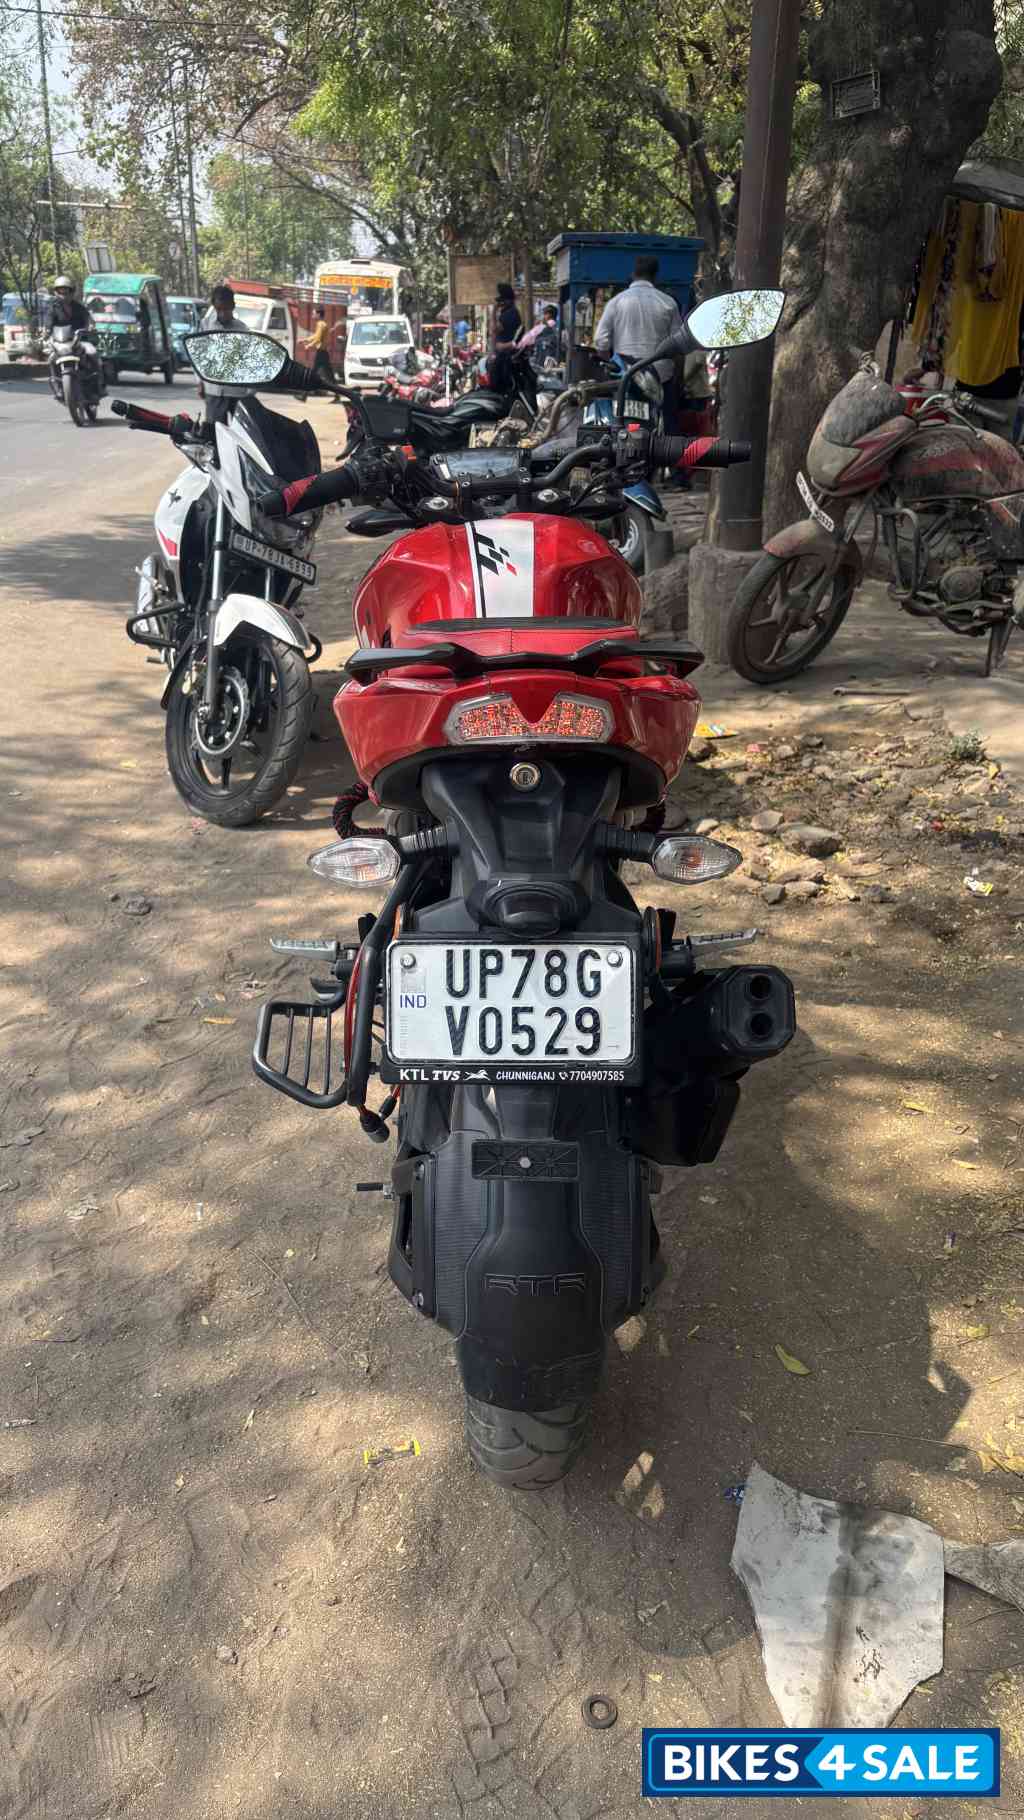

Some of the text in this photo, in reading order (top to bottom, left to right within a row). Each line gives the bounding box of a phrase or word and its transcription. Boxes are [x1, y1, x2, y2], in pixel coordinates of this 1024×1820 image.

[446, 948, 602, 999] UP78G
[400, 994, 427, 1009] IND
[445, 1005, 601, 1056] V0529
[400, 1068, 429, 1081] KTL
[432, 1070, 461, 1081] TVS
[496, 1071, 555, 1081] CHUNNIGANJ
